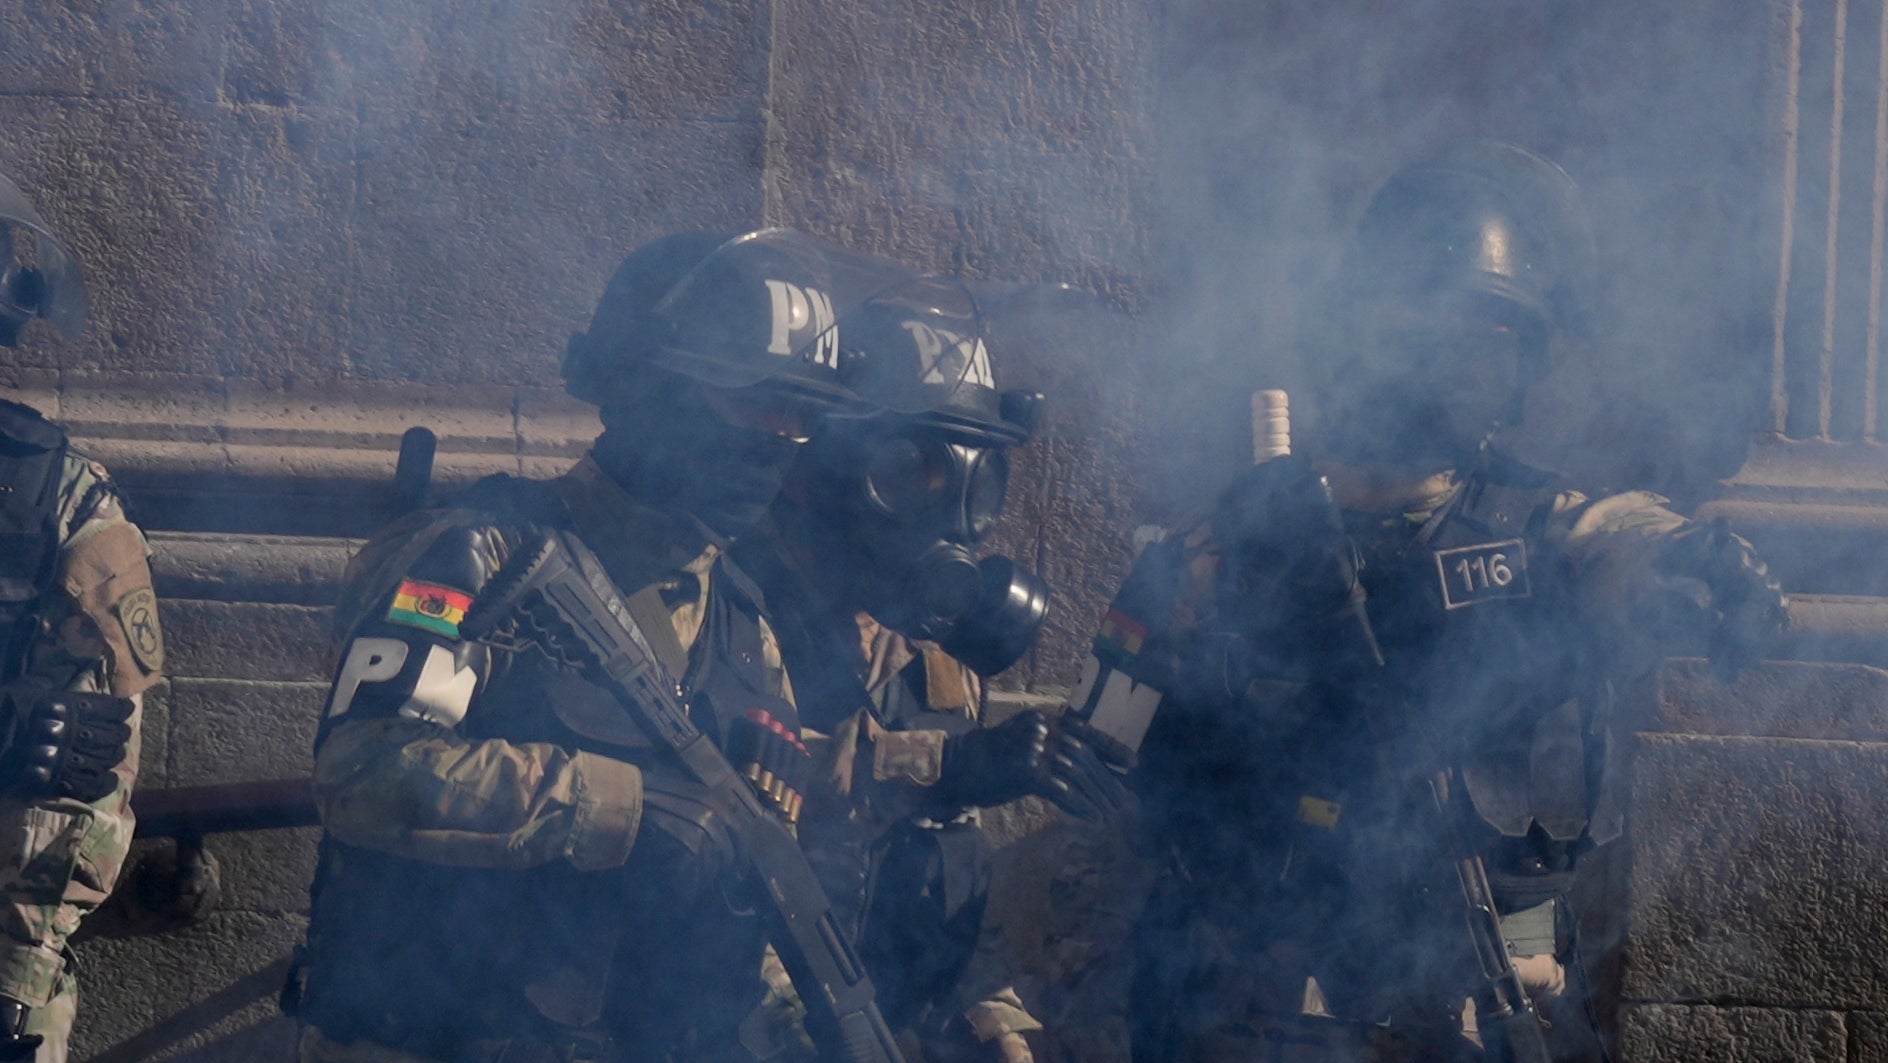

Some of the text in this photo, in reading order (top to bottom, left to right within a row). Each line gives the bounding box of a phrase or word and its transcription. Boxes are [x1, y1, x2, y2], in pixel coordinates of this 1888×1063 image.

[765, 279, 839, 370] PM
[1456, 552, 1513, 591] 116
[328, 637, 479, 728] PM
